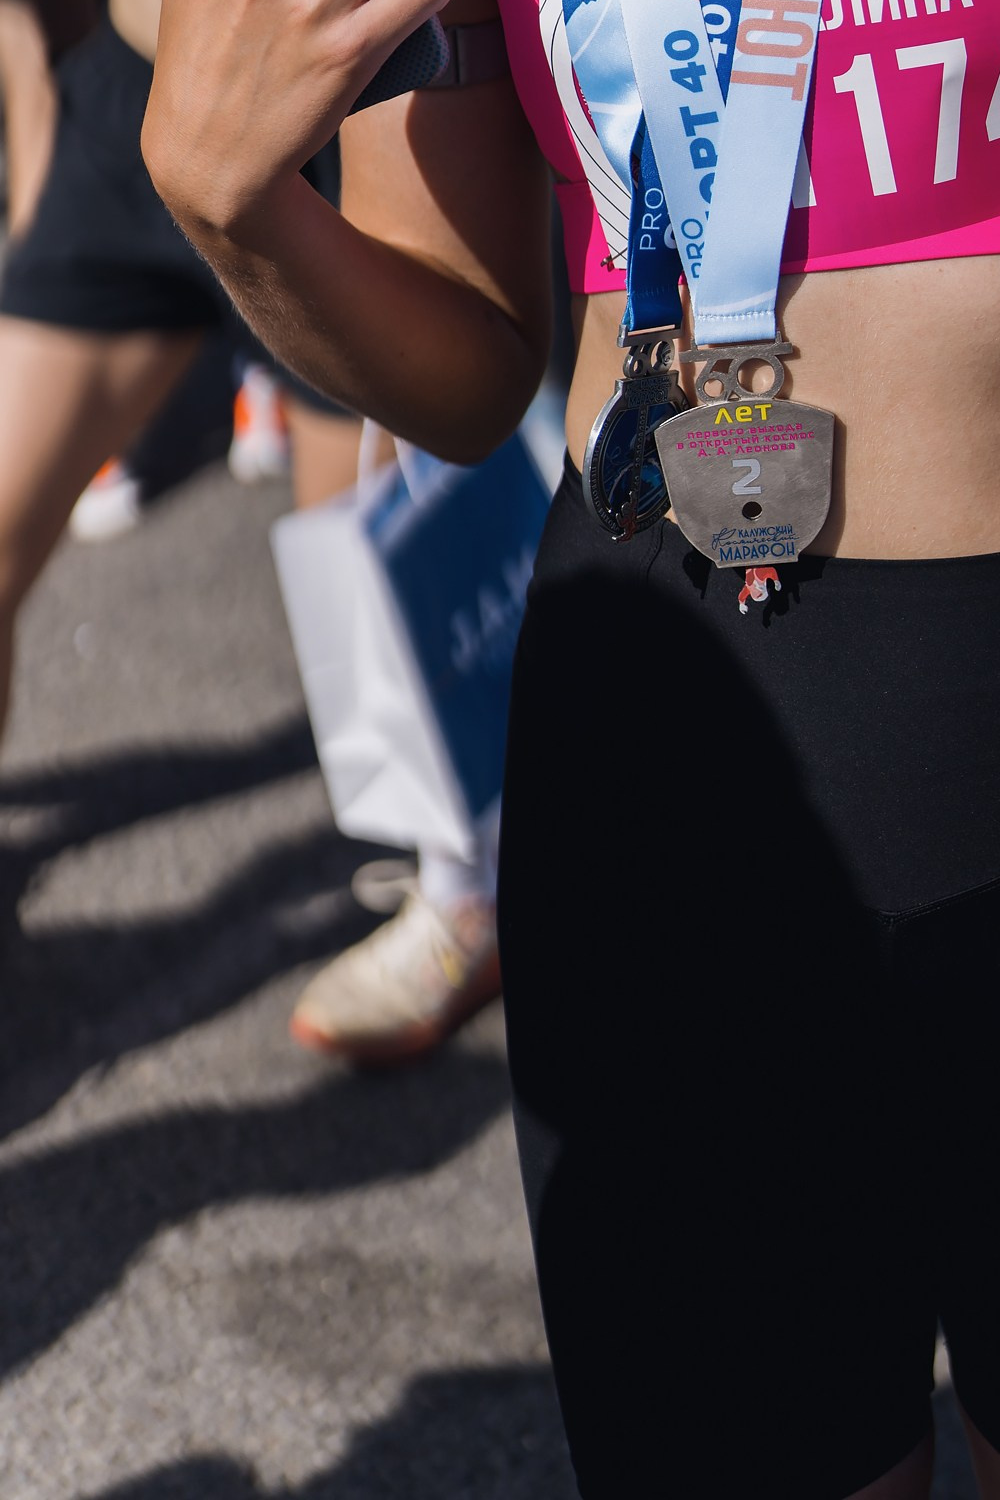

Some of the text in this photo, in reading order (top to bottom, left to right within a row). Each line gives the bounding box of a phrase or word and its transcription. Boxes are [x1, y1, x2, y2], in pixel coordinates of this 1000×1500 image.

[664, 29, 707, 94] 40
[639, 187, 665, 251] PRO
[676, 431, 815, 450] в открытый космос
[687, 422, 803, 440] первого выхода
[697, 442, 796, 458] А. А. Леонова
[731, 458, 762, 496] 2
[738, 523, 794, 538] КАЛУЖСКИЙ
[719, 541, 795, 561] МАРАФОН
